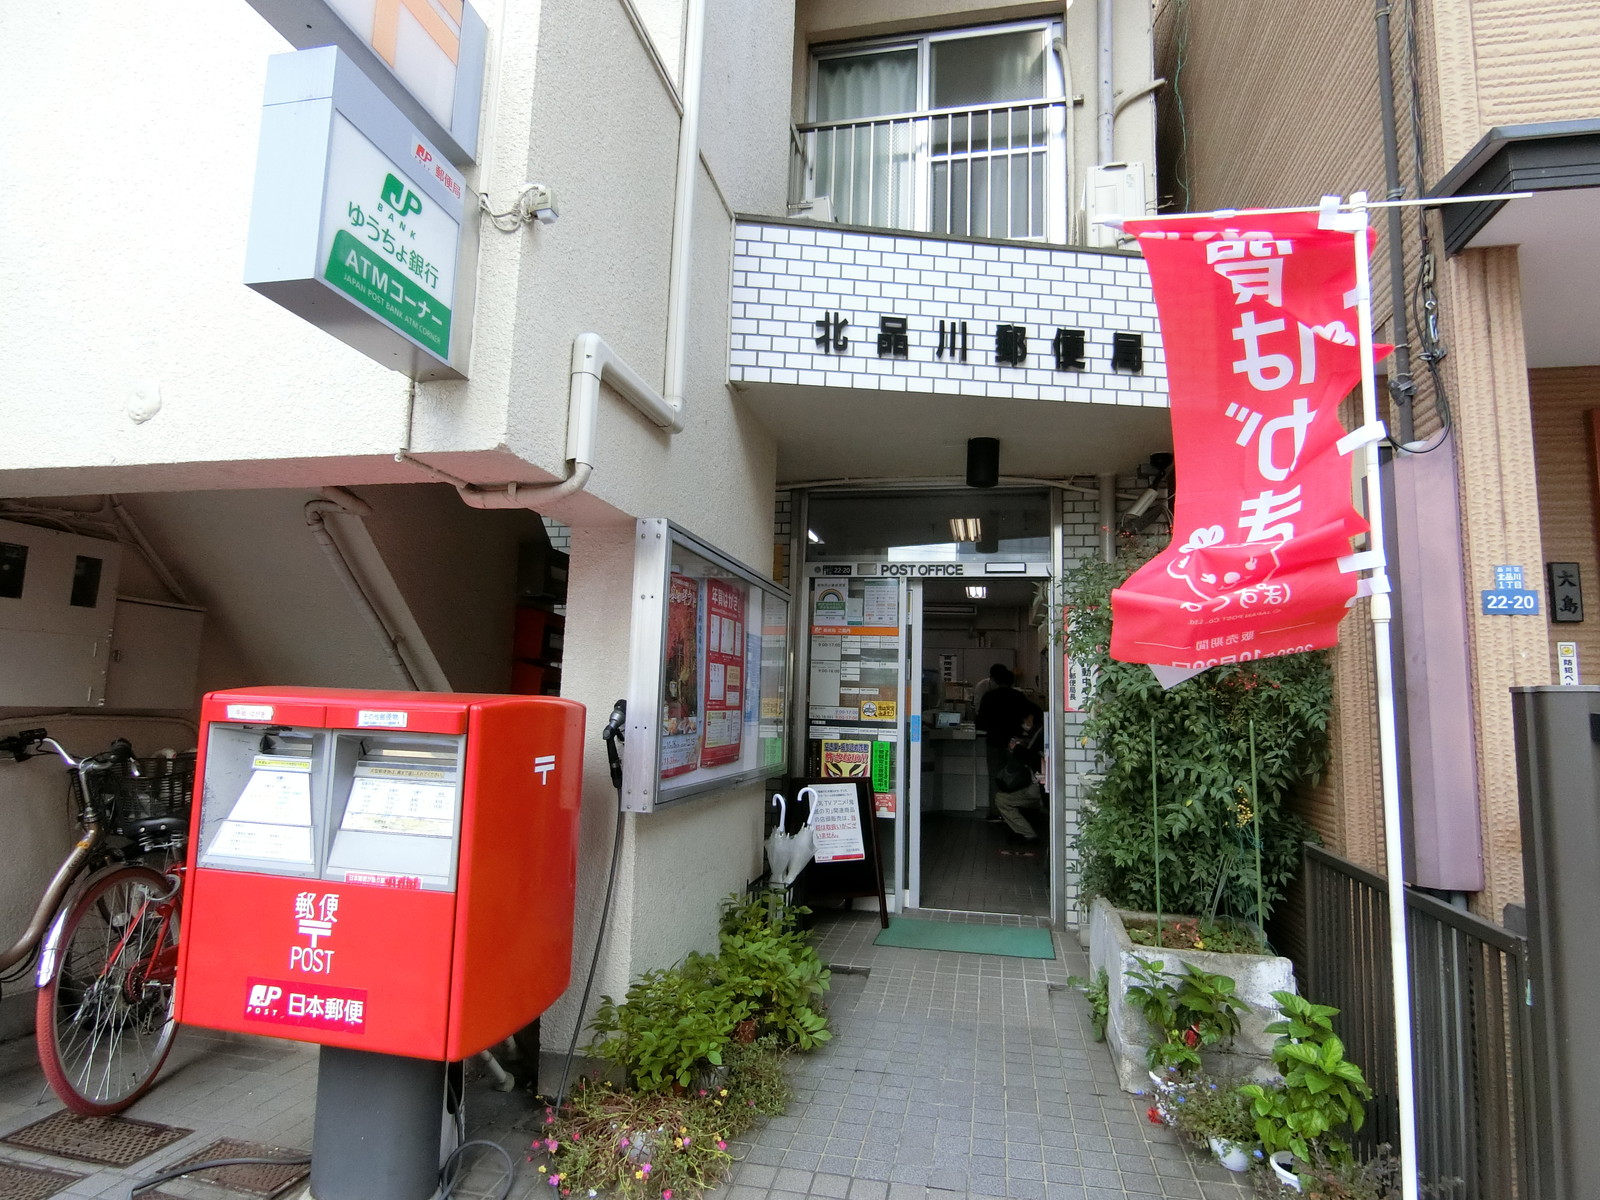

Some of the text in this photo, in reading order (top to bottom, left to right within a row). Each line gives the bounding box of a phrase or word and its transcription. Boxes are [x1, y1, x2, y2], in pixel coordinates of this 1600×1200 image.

[380, 172, 423, 217] JP
[435, 164, 461, 199] 郵便局
[377, 202, 417, 241] BANK
[348, 200, 439, 290] ゆうちょ銀行
[345, 248, 442, 326] ATMコーナー
[343, 273, 441, 345] JAPAN POST BANK ATM CORNER
[814, 310, 1143, 375] 北品川郵便局
[881, 564, 964, 577] POST OFFICE
[1496, 573, 1522, 581] 北品川
[1498, 581, 1522, 589] 1丁目
[1487, 595, 1534, 609] 22-20
[1562, 659, 1574, 685] 防犯ベ
[295, 891, 340, 923] 郵便
[290, 946, 335, 974] POST
[249, 984, 282, 1007] JP
[289, 994, 364, 1024] 日本郵便
[247, 1006, 279, 1017] POST
